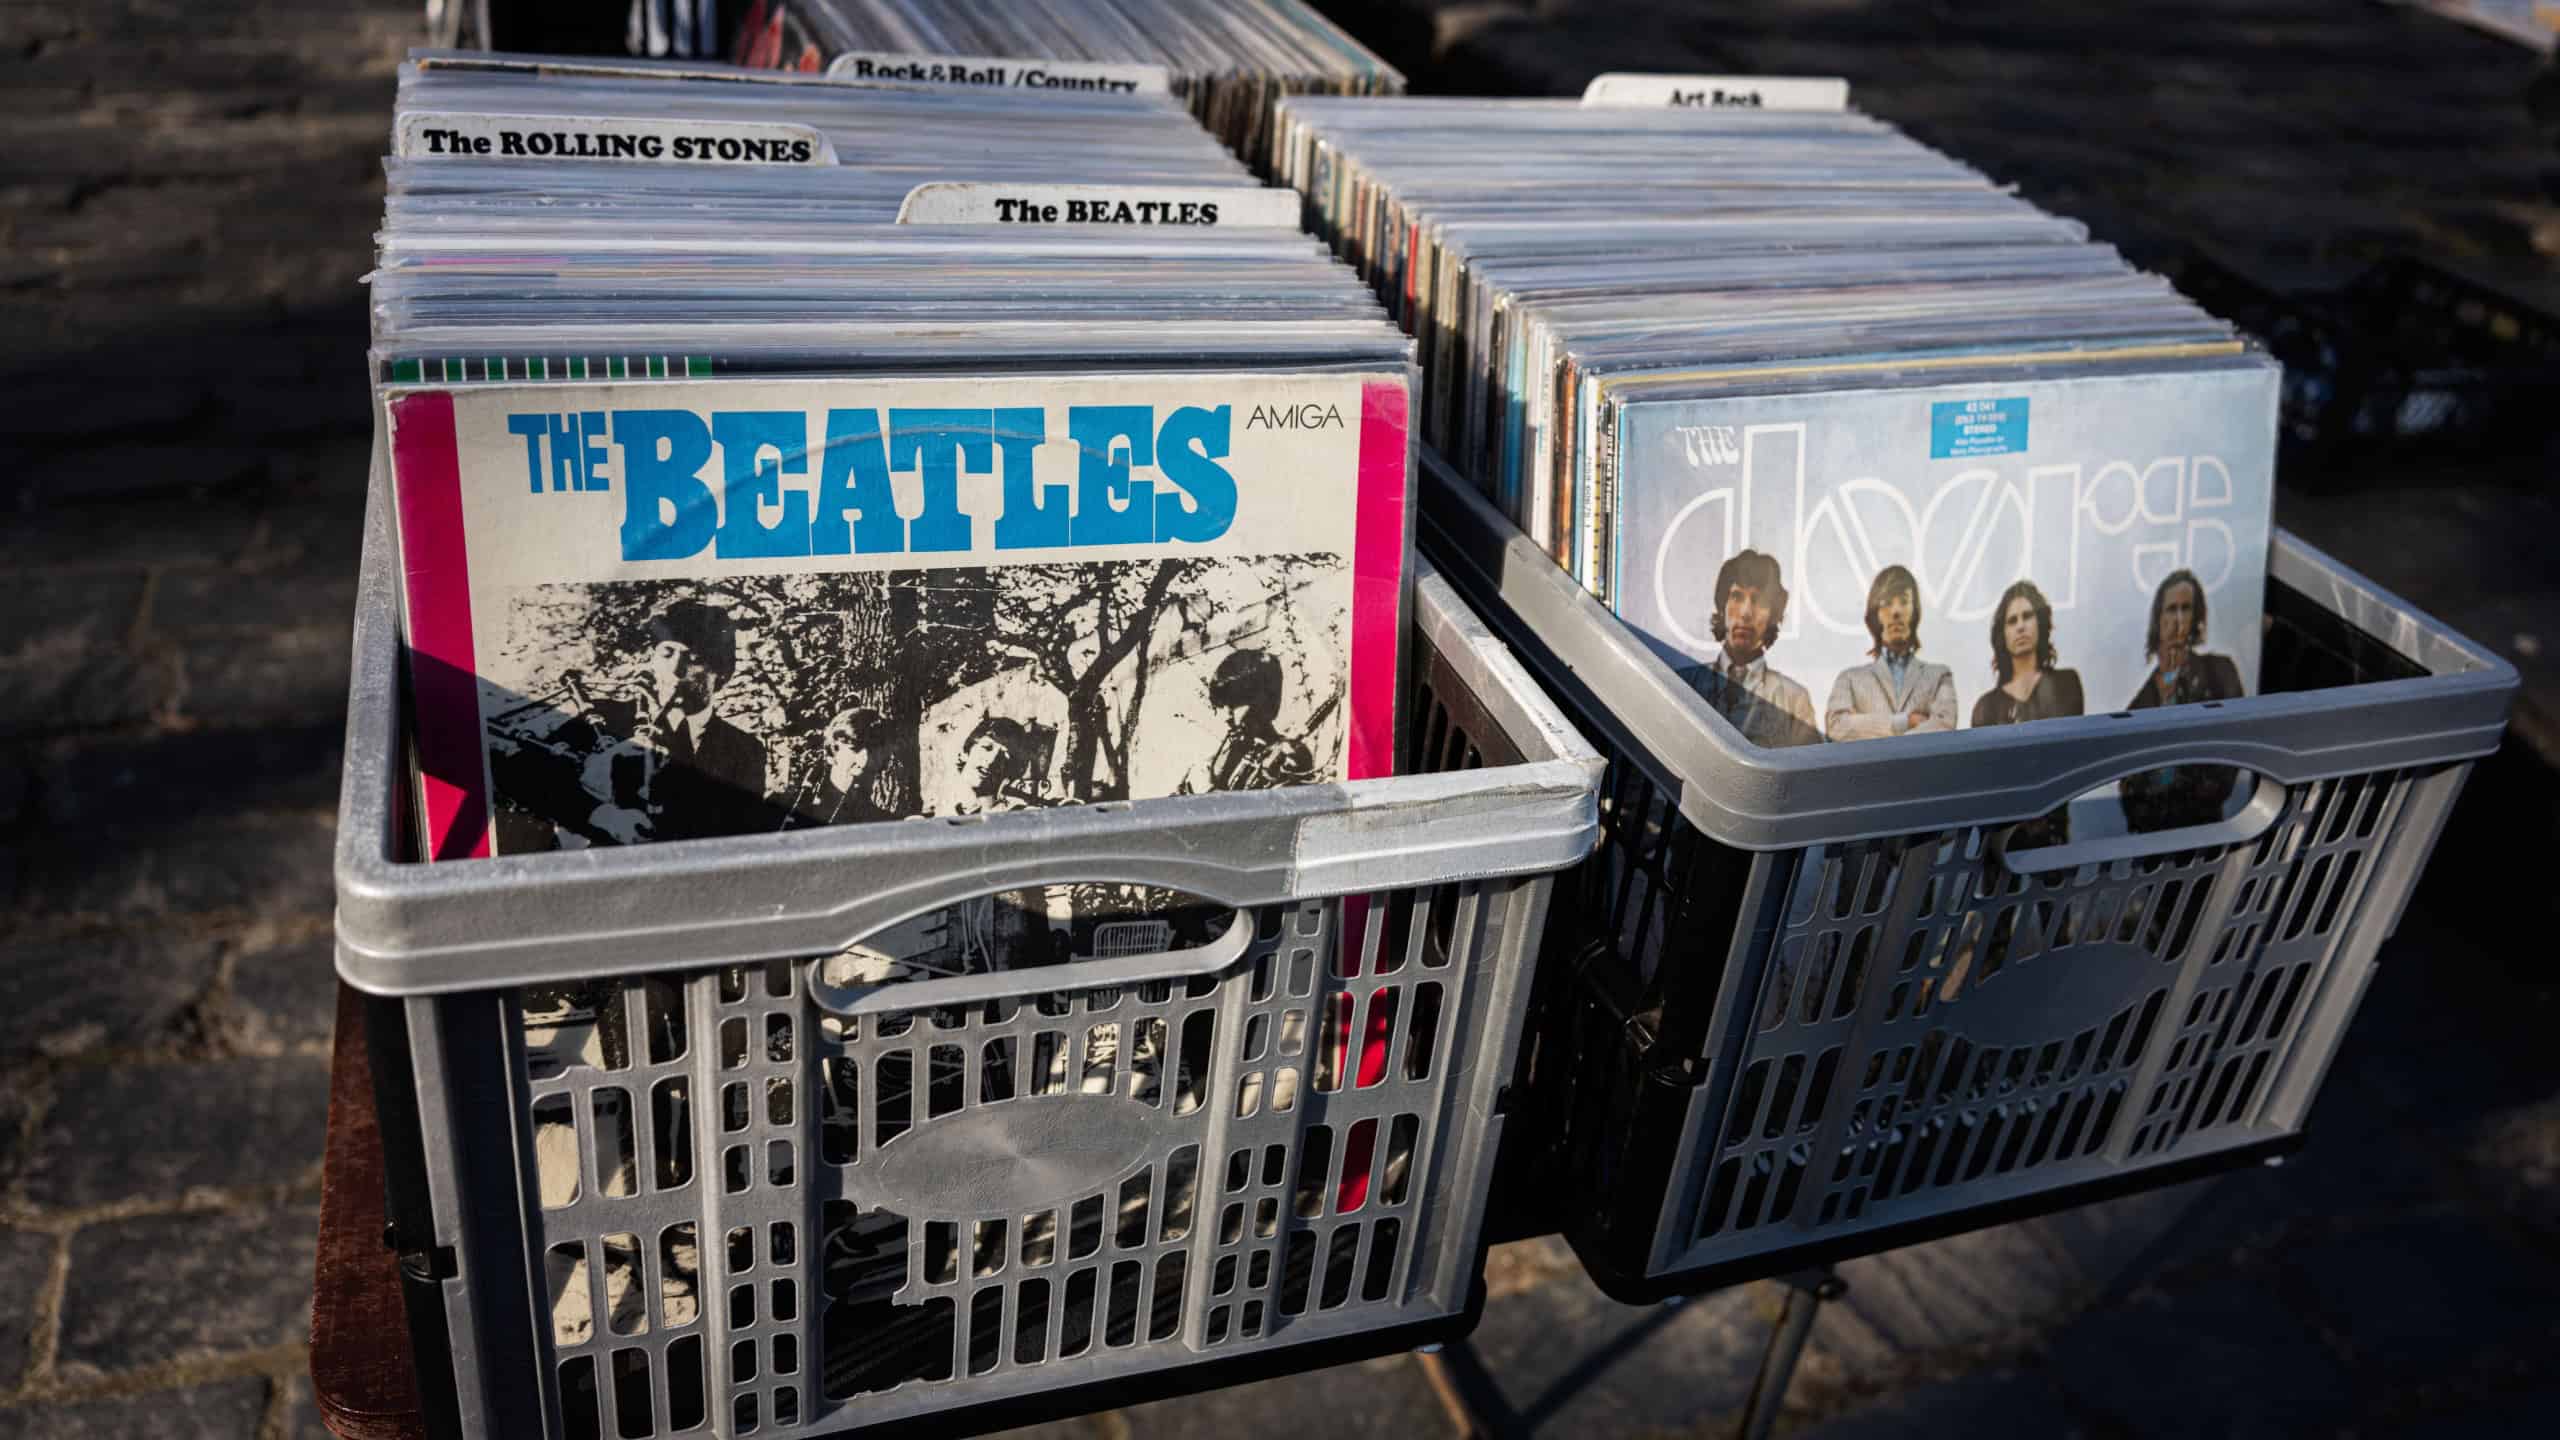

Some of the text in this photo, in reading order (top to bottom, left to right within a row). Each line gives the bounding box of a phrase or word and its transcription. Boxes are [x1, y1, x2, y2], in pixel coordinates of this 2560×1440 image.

[1669, 89, 1763, 108] Art Rock
[422, 128, 812, 163] The ROLLING STONES
[994, 198, 1218, 225] The BEATLES
[1245, 403, 1345, 431] AMIGA
[1675, 426, 1740, 467] THE
[508, 403, 1238, 562] THE BEATLES
